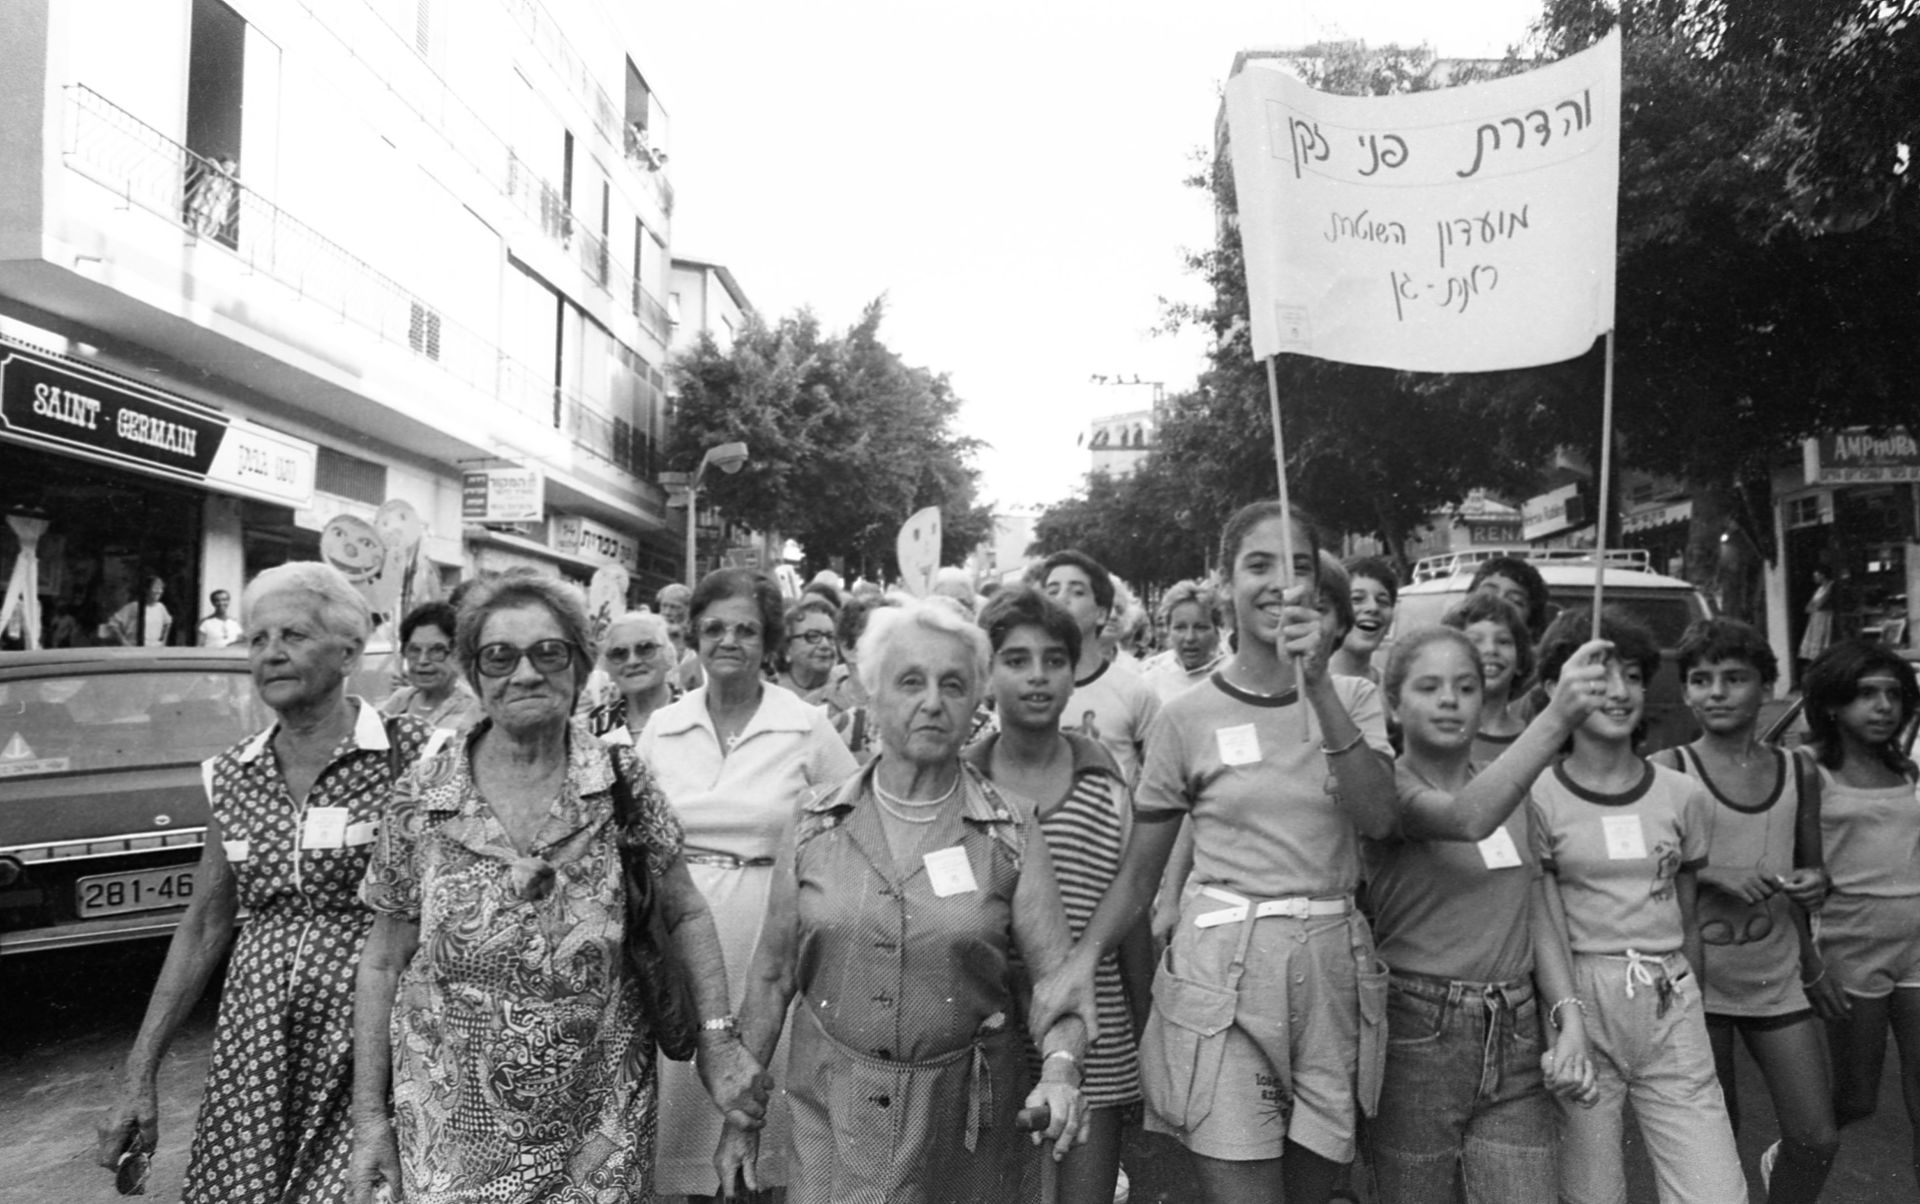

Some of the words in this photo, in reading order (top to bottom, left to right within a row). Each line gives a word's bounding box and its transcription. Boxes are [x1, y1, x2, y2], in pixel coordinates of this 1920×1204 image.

[1288, 116, 1331, 179] זקן
[1357, 134, 1410, 177] פני
[1456, 89, 1592, 178] והדרת
[1437, 204, 1529, 268] מועדון
[32, 383, 101, 430] SAINT
[116, 408, 197, 457] GERMAIN
[85, 872, 194, 909] 281-46
